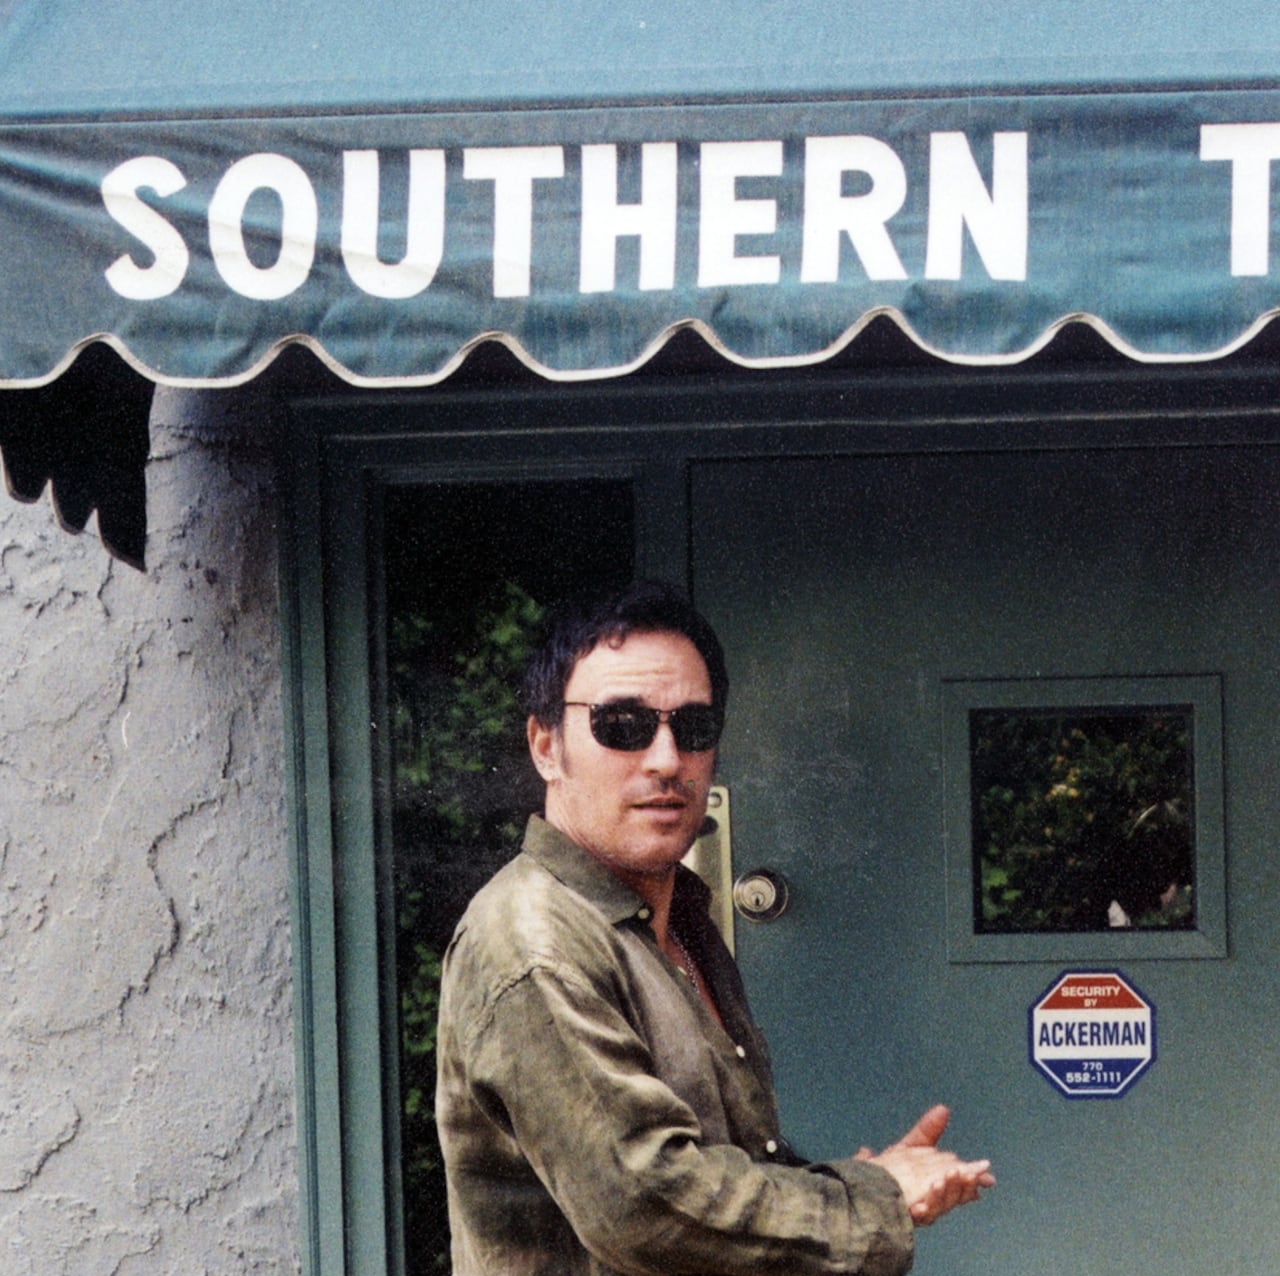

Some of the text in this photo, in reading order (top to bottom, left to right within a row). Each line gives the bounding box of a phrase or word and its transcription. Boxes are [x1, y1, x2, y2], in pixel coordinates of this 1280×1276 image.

[100, 131, 1029, 301] SOUTHERN
[1061, 986, 1121, 997] SECURITY
[1084, 999, 1098, 1007] BY
[1039, 1021, 1146, 1047] ACKERMAN
[1082, 1062, 1103, 1071] 770
[1066, 1072, 1121, 1083] 552-1111
